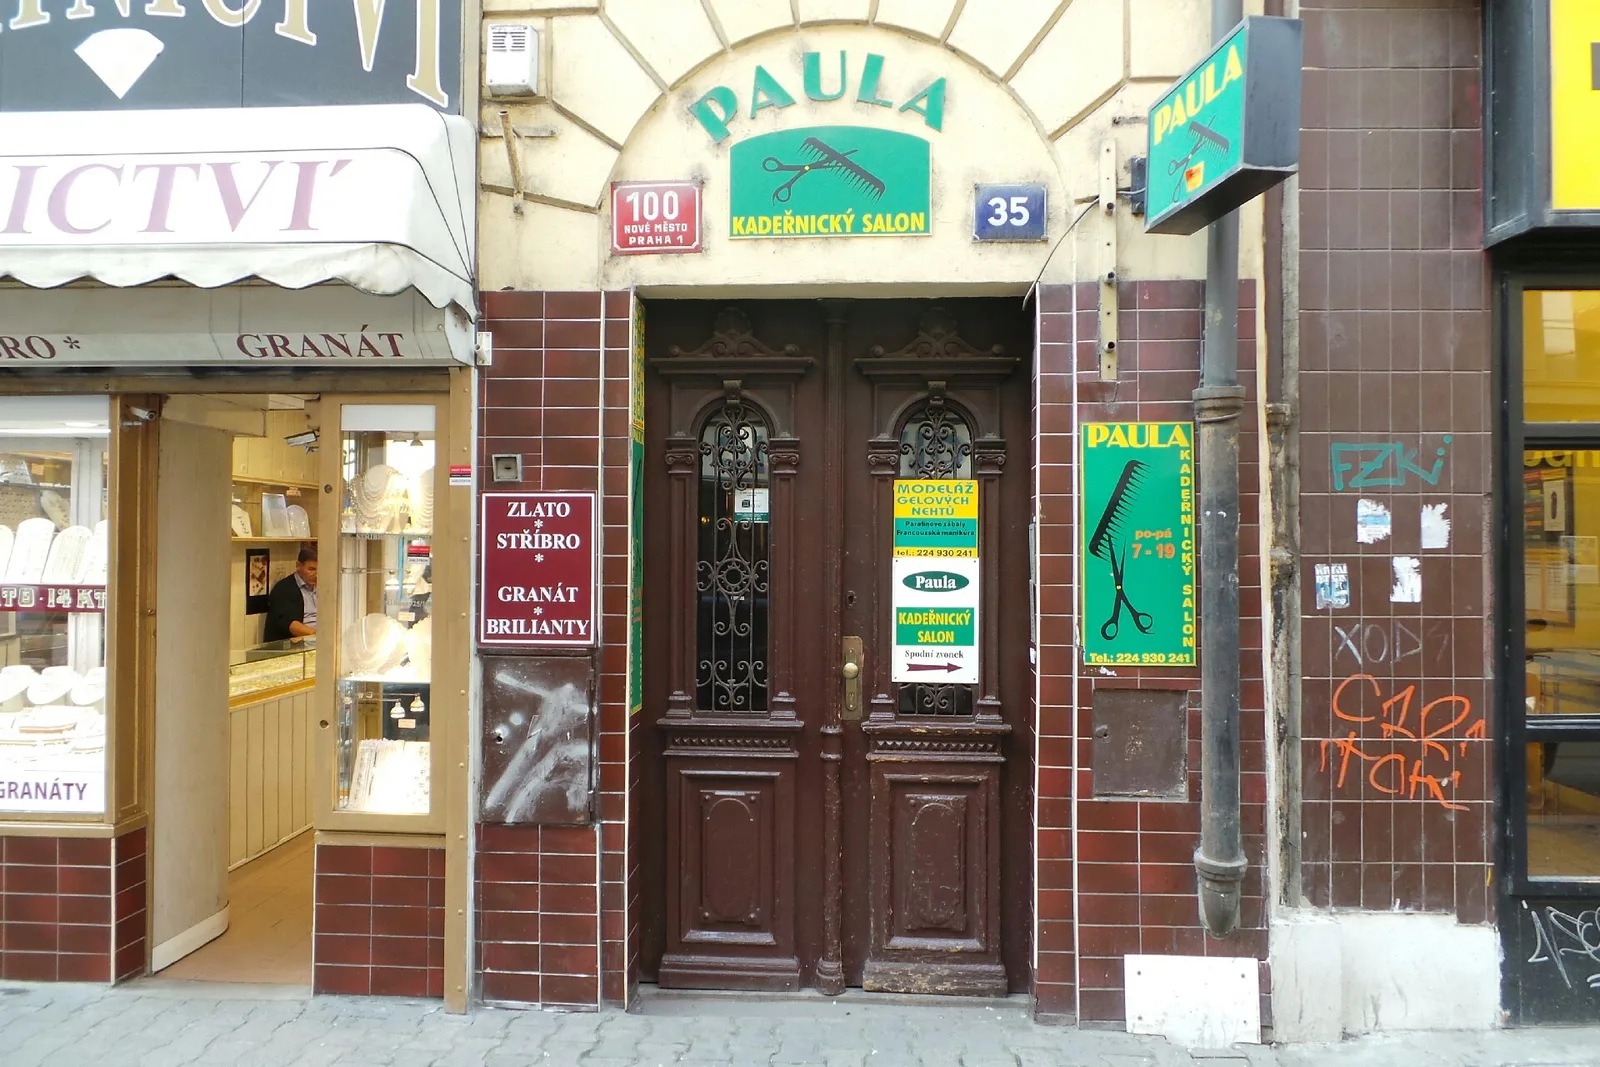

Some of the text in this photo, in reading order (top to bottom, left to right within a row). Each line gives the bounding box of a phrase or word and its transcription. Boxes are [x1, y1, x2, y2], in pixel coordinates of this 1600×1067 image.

[688, 50, 947, 144] PAULA
[1154, 45, 1243, 146] PAULA
[626, 190, 679, 222] 100
[987, 196, 1031, 226] 35
[624, 220, 688, 234] NOVÉ MĚSTO
[732, 208, 925, 235] KADEŘNICKÝ SALON
[628, 235, 684, 245] PRAHA 1
[236, 324, 404, 359] GRANÁT
[1088, 424, 1190, 448] PAULA
[897, 482, 974, 494] MODELÁŽ
[897, 494, 970, 505] GELOVÝCH
[507, 502, 570, 517] ZLATO
[496, 529, 580, 549] STŘÍBRO
[1135, 528, 1172, 540] po-pá
[1132, 543, 1142, 558] 7
[1156, 543, 1175, 559] 19
[915, 575, 957, 589] Paula
[497, 583, 579, 603] GRANÁT
[898, 609, 971, 626] KADEŘNICKÝ
[1182, 584, 1193, 648] SALON
[486, 619, 590, 636] BRILIANTY
[917, 630, 955, 643] SALON
[904, 650, 965, 660] Spodní zvonek
[1089, 653, 1190, 663] Tel.: 224 930 241
